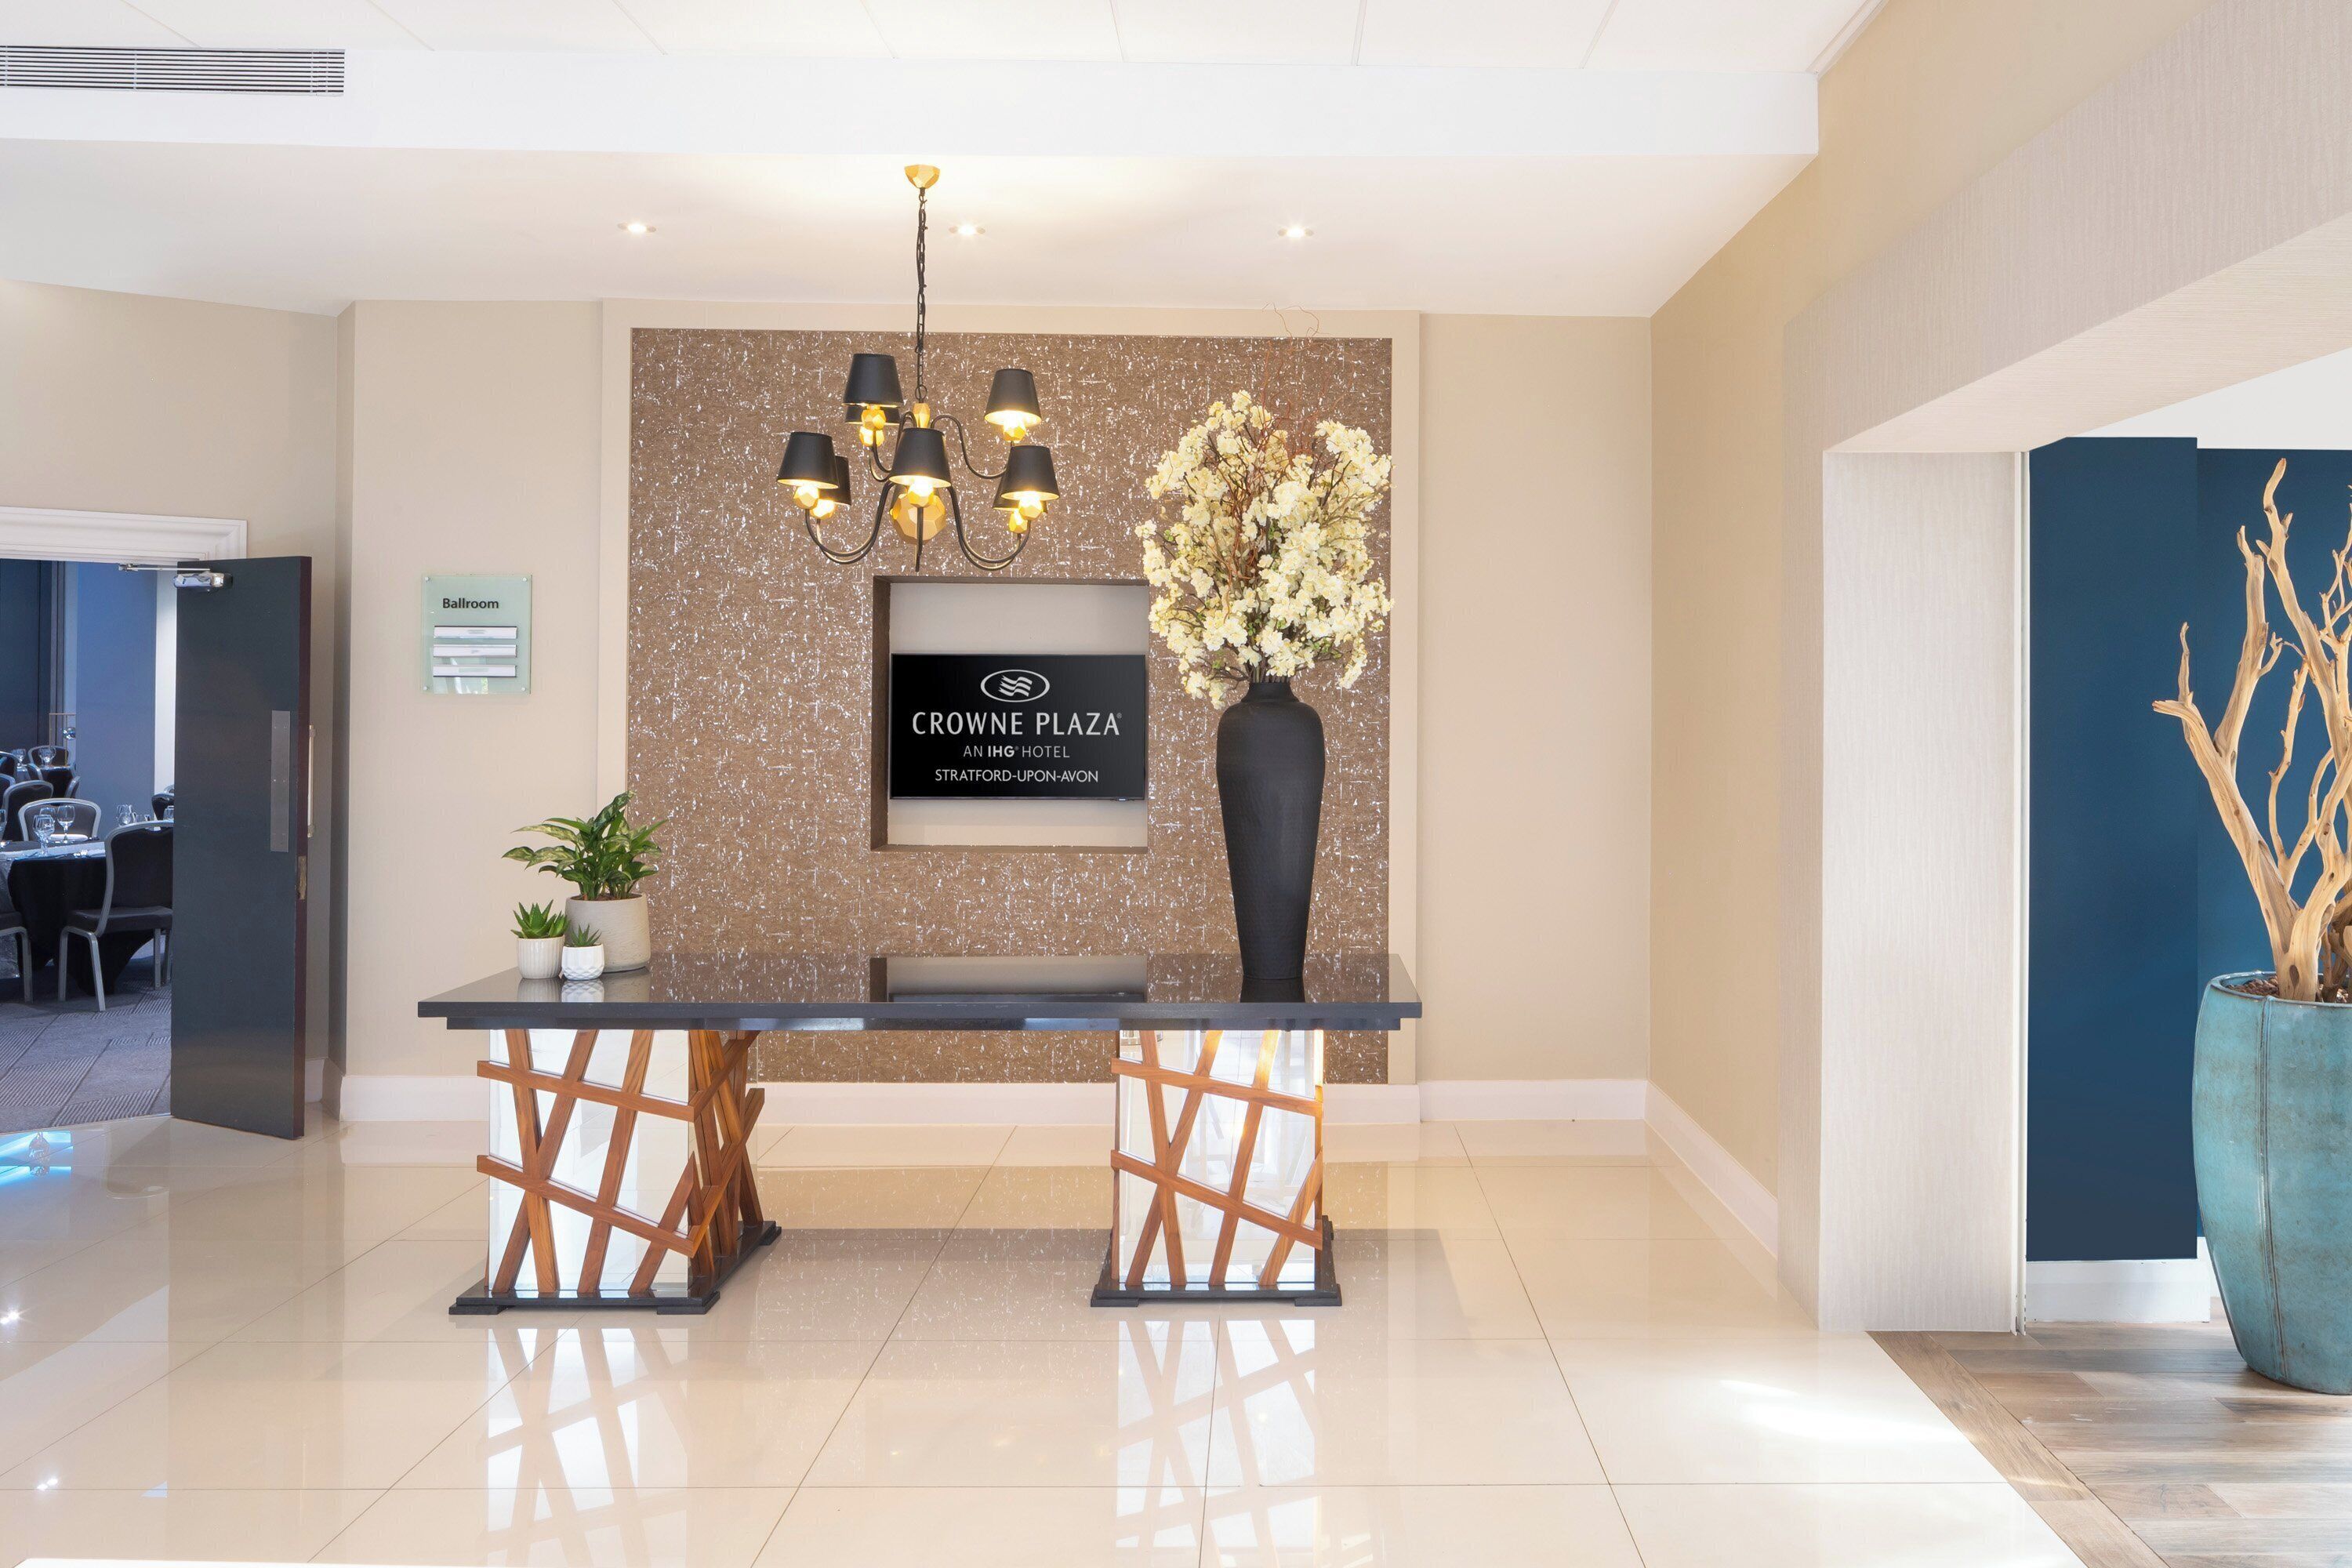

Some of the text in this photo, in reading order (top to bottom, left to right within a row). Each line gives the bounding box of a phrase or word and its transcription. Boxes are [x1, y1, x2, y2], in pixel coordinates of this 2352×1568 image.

[442, 597, 499, 609] Ballroom
[912, 711, 1023, 735] CROWNE
[963, 745, 982, 757] AN
[1022, 746, 1070, 758] HOTEL
[935, 768, 1098, 782] STRATFORD-UPON-AVON
